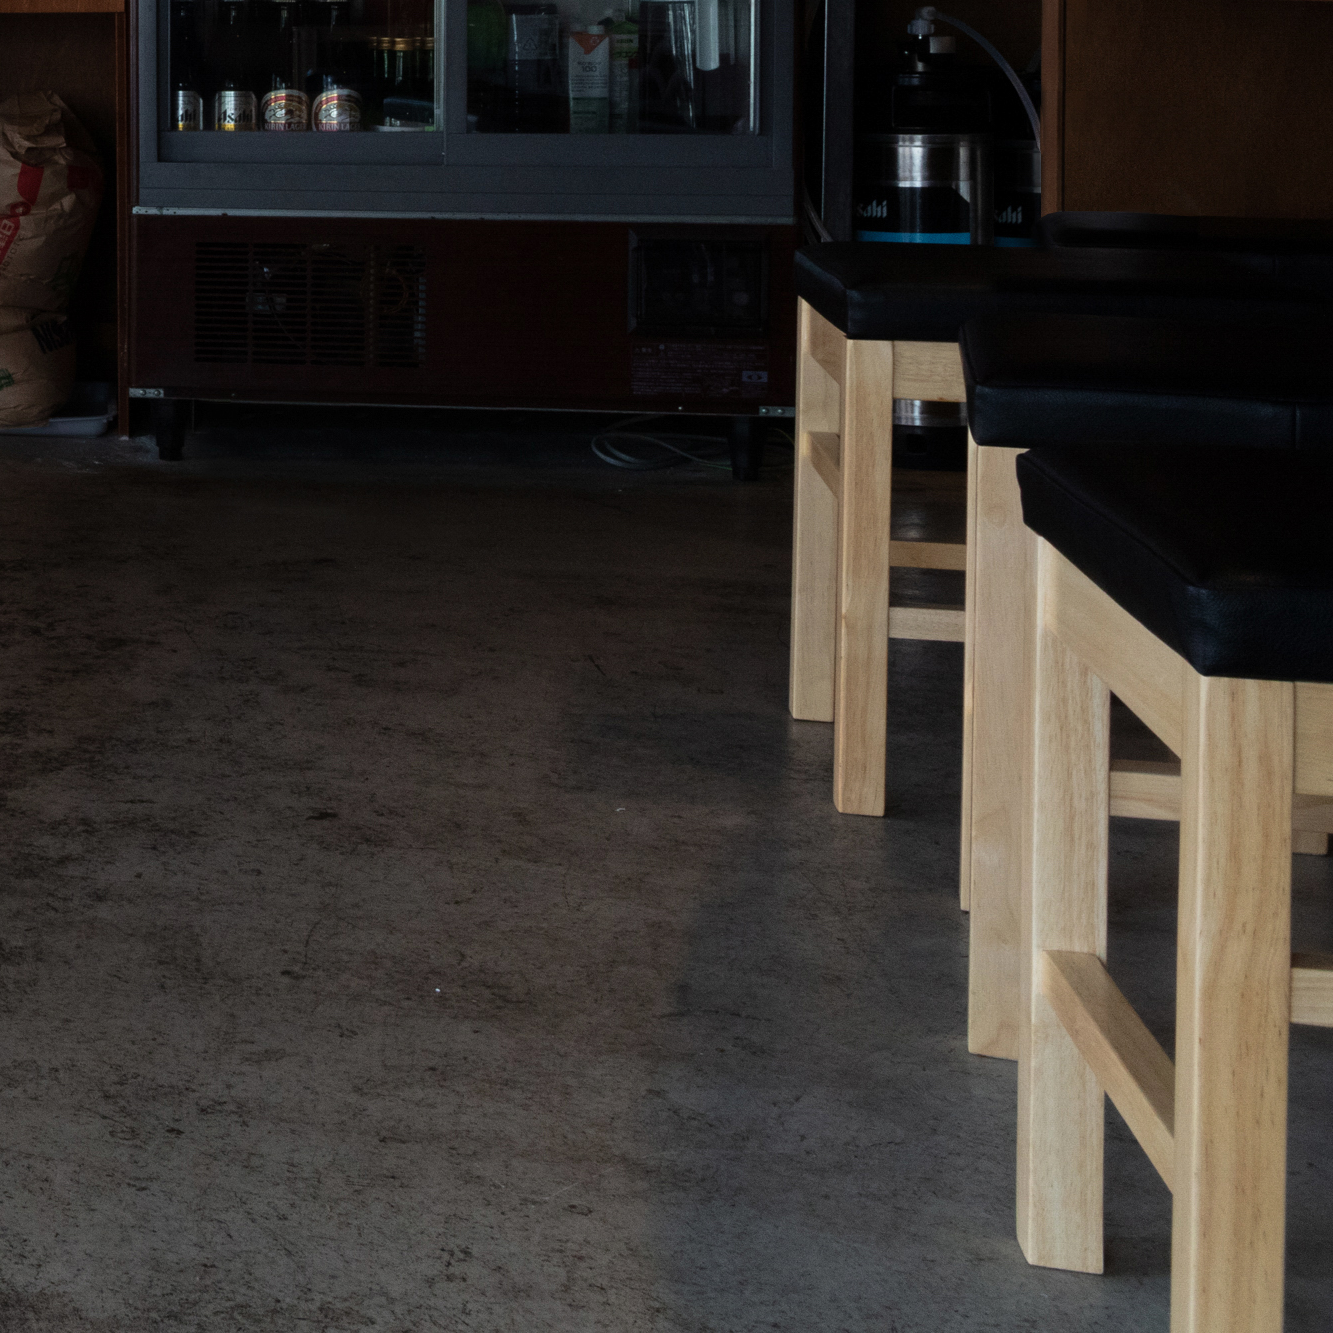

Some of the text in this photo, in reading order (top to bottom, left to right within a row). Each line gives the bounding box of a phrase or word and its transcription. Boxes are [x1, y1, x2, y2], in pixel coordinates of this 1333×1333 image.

[216, 107, 254, 125] Asahi
[265, 122, 284, 131] KIRIN
[319, 122, 339, 131] KIRIN
[856, 198, 888, 219] sahi
